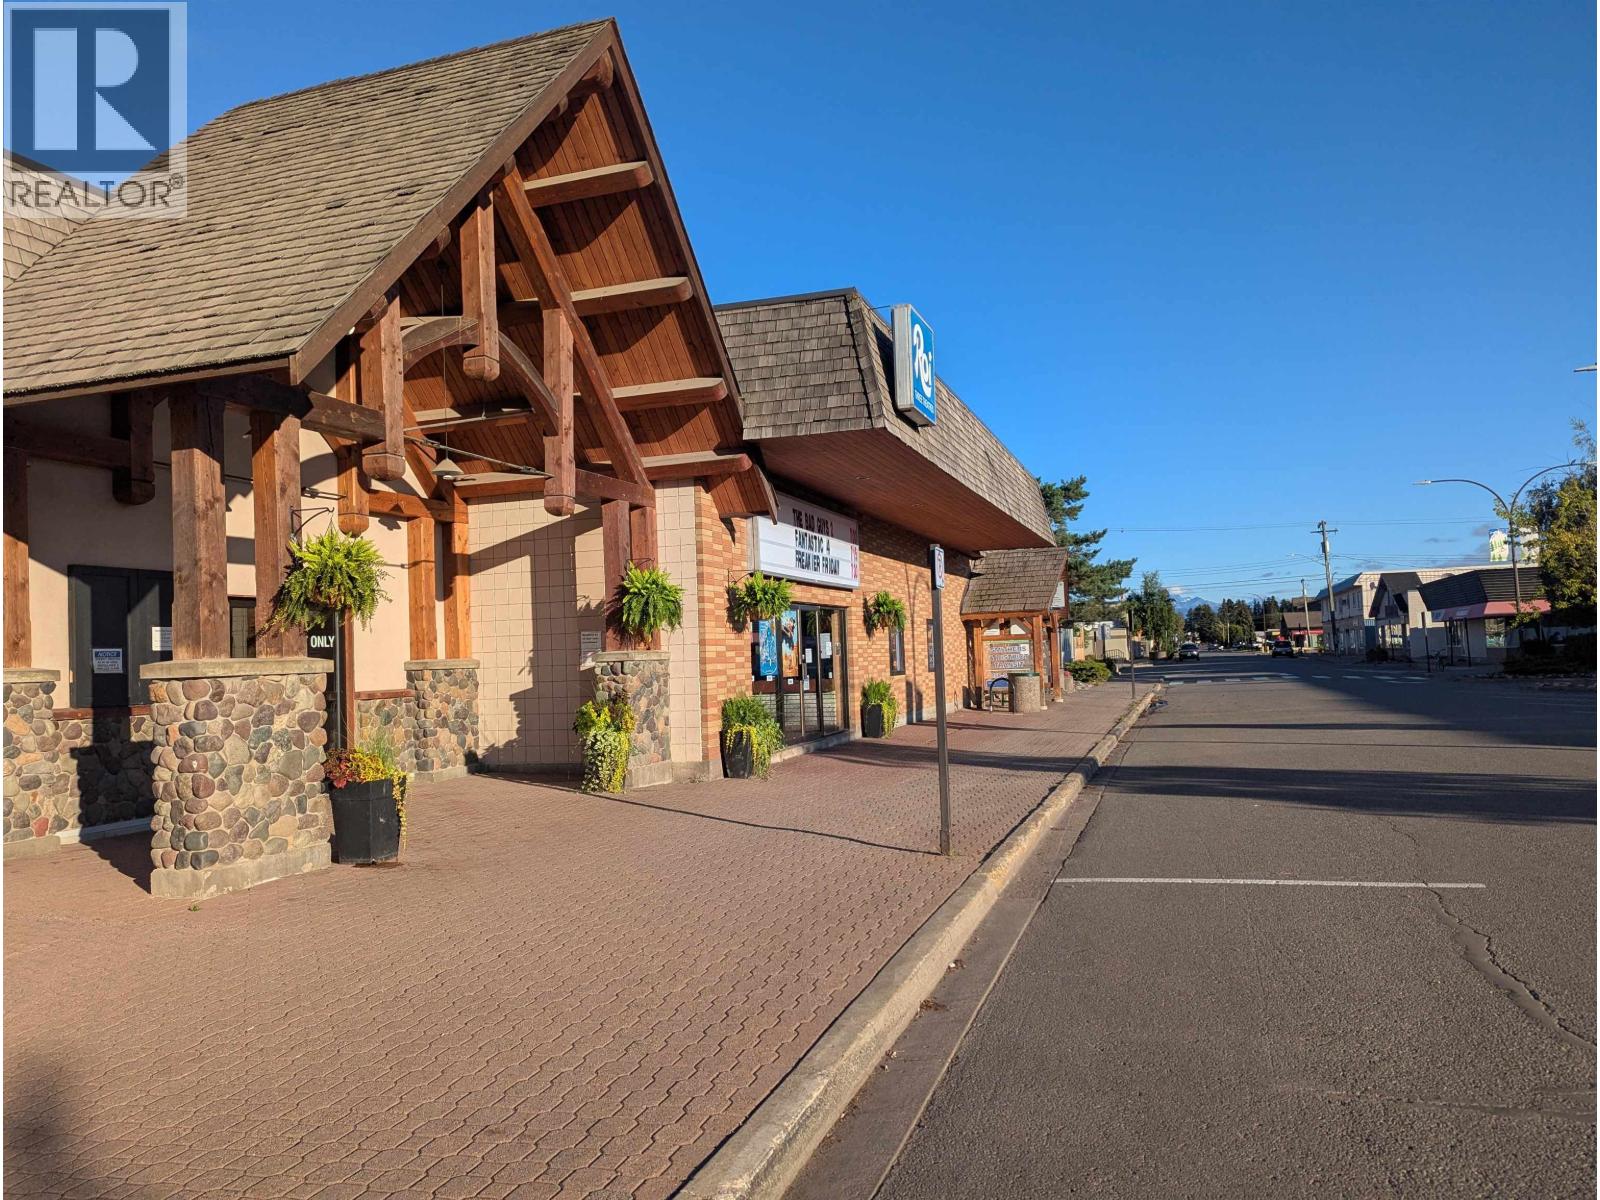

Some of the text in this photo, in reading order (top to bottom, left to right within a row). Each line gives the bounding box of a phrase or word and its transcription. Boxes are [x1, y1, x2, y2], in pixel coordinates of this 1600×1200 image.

[792, 508, 803, 528] THE
[805, 512, 815, 533] BAD
[794, 529, 831, 555] FANTASTIC 4
[795, 550, 840, 575] FREAKIER FRIDAY
[310, 635, 335, 648] ONLY
